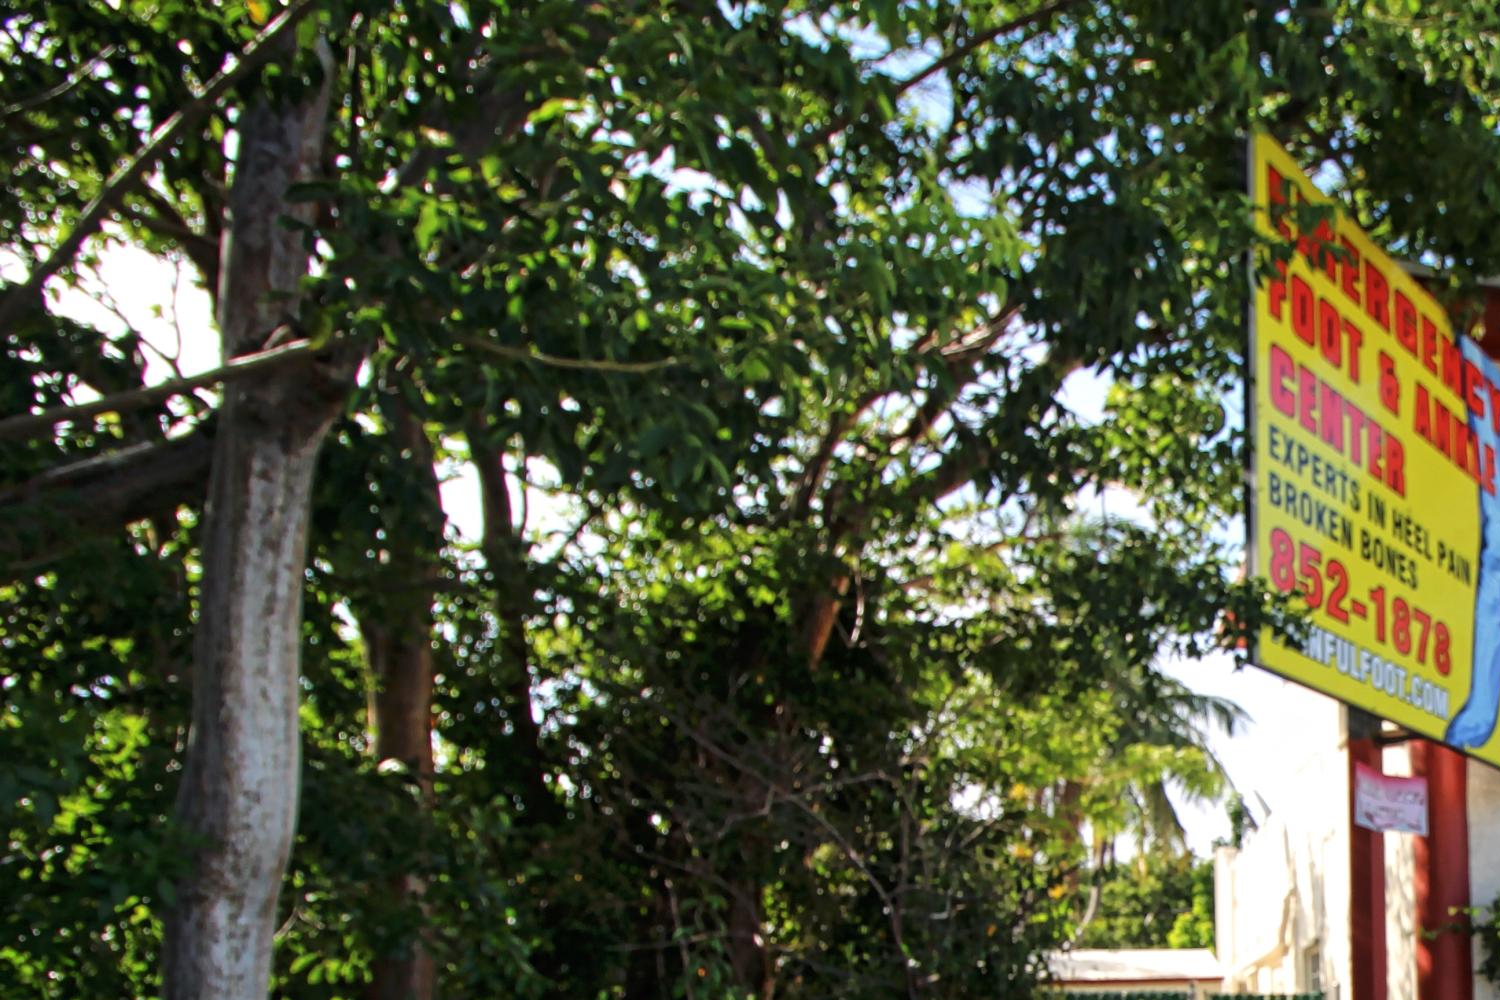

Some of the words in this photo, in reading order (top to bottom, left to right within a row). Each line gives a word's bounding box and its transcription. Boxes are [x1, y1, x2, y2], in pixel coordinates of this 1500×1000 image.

[1268, 258, 1362, 387] FOOT
[1379, 349, 1400, 418] &
[1415, 381, 1496, 497] ANKLE
[1270, 343, 1405, 499] CENTER
[1268, 470, 1353, 551] BROKEN
[1360, 528, 1418, 590] BONES
[1269, 424, 1361, 513] EXPERTS
[1367, 490, 1386, 530] IN
[1392, 508, 1431, 562] HEEL
[1438, 540, 1471, 587] PAIN
[1270, 528, 1452, 678] 852-1878
